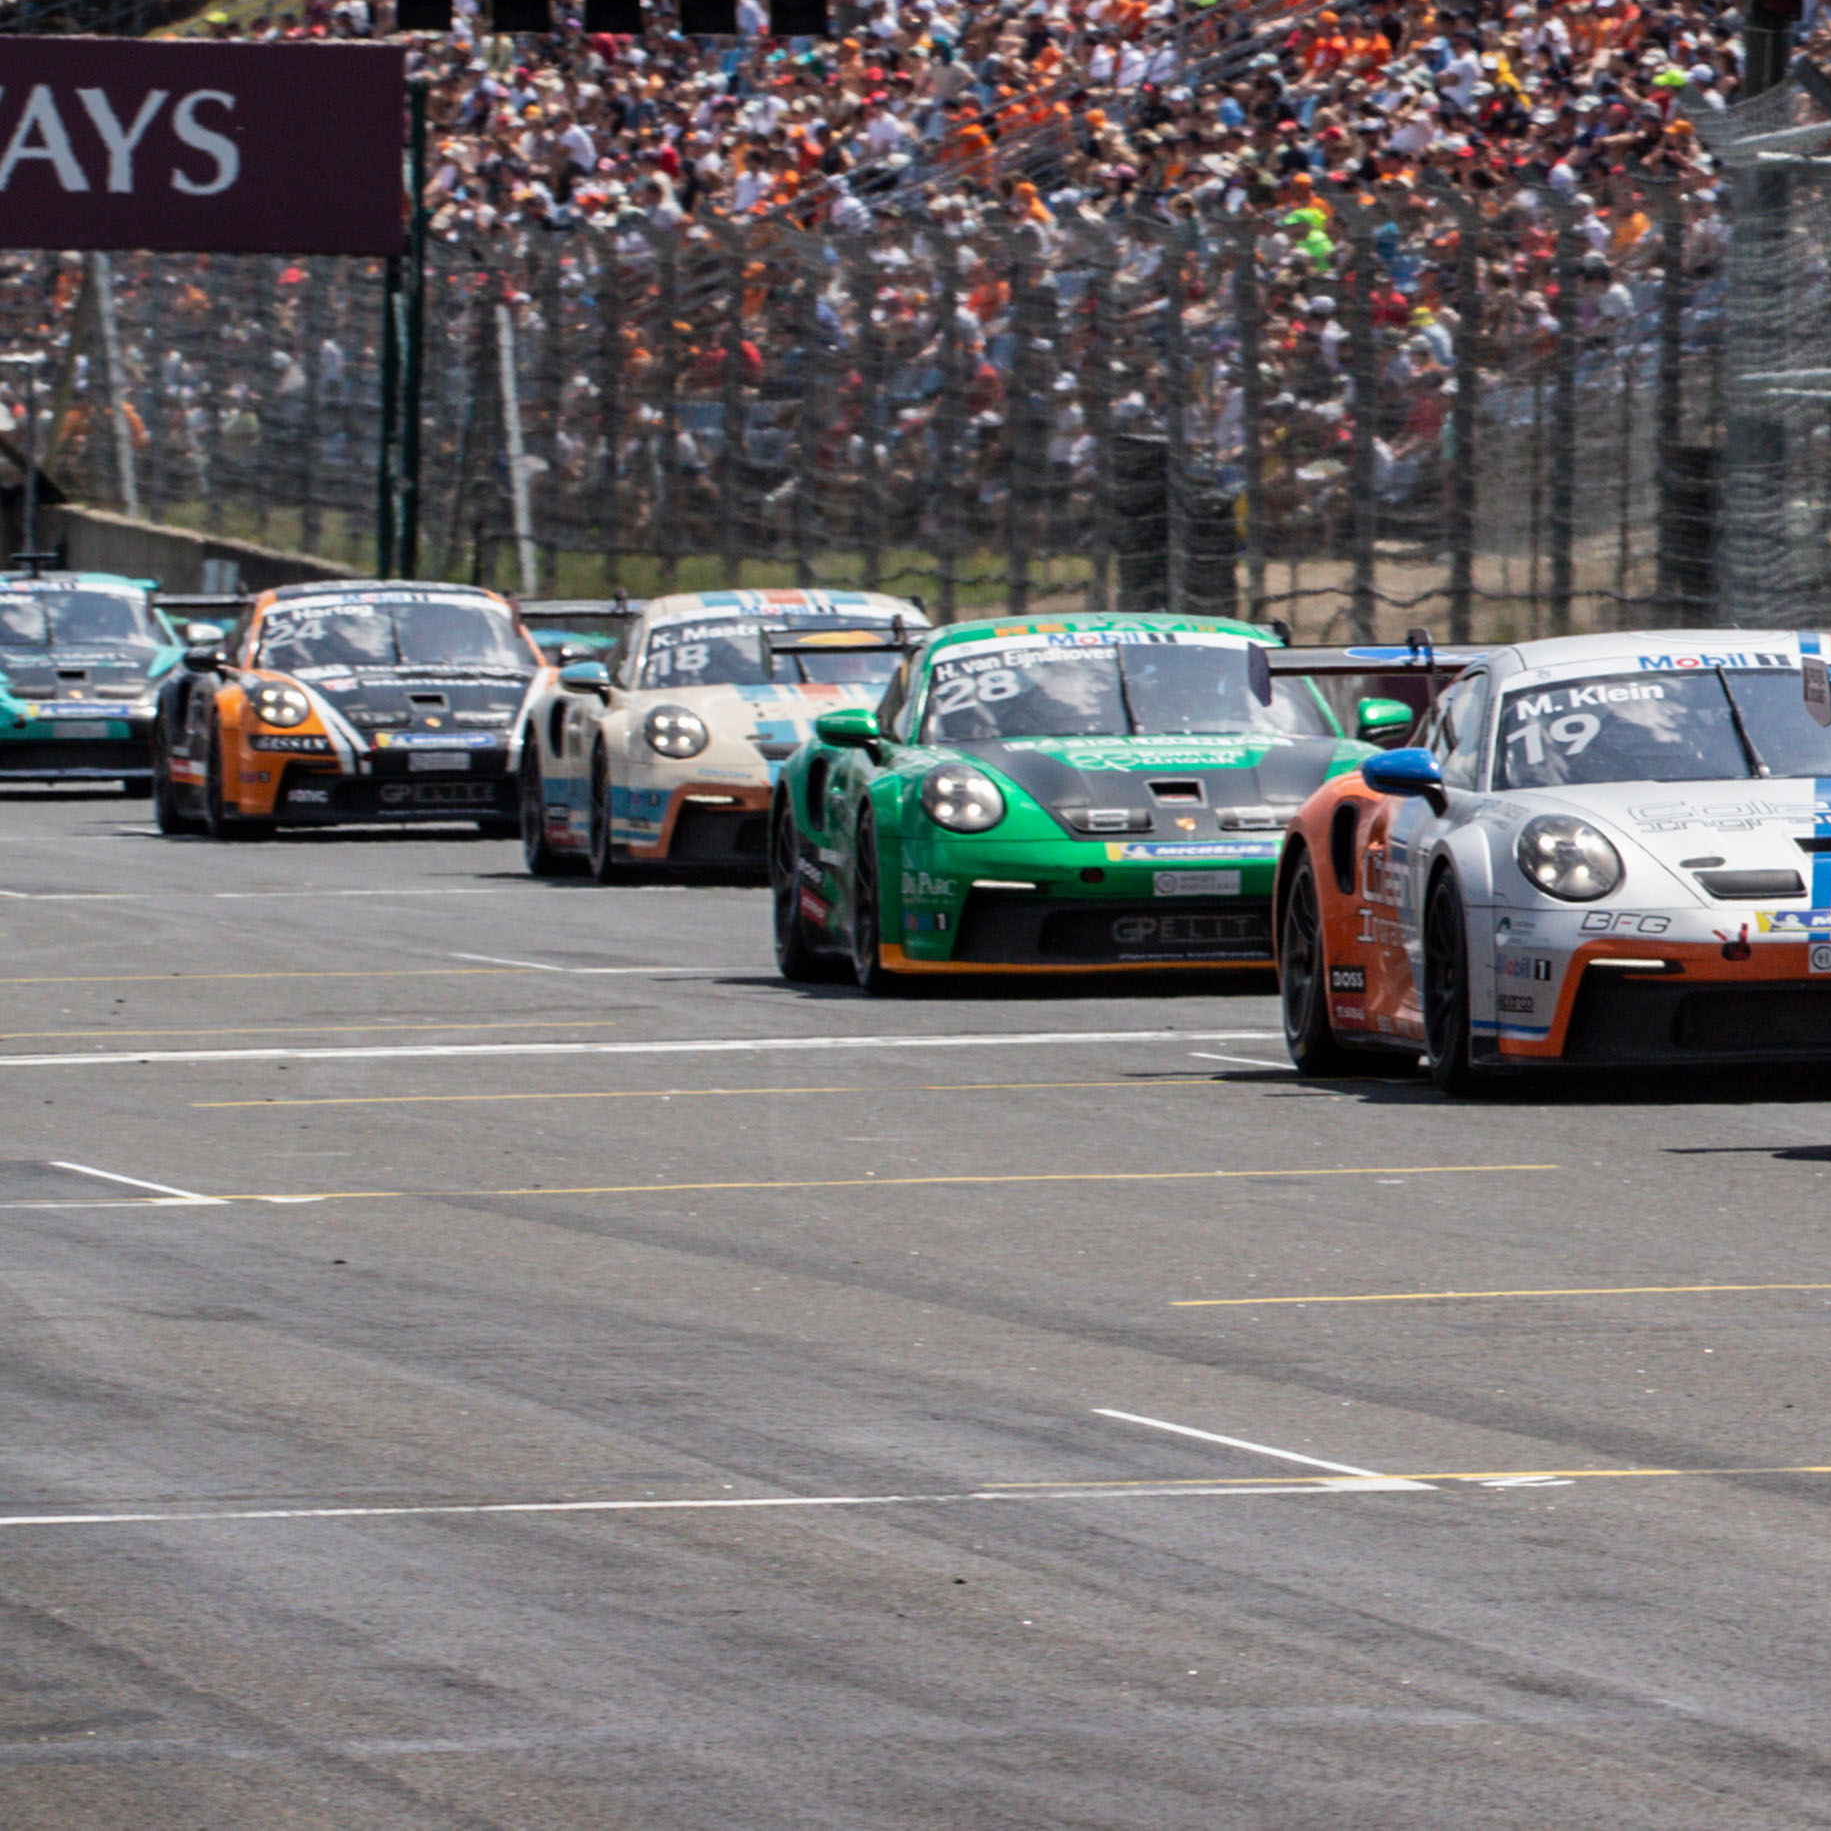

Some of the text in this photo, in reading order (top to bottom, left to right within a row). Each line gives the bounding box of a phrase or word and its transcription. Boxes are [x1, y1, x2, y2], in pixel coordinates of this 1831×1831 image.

[0, 83, 241, 196] AYS
[264, 620, 327, 648] 24
[1047, 632, 1141, 646] Mobil
[648, 643, 711, 677] 18
[936, 665, 961, 683] H.
[964, 656, 1002, 673] van
[1638, 653, 1748, 670] Mobil
[935, 670, 1022, 715] 28
[1516, 682, 1664, 720] M. Klein
[1506, 713, 1601, 766] 19
[1580, 910, 1672, 935] BFG
